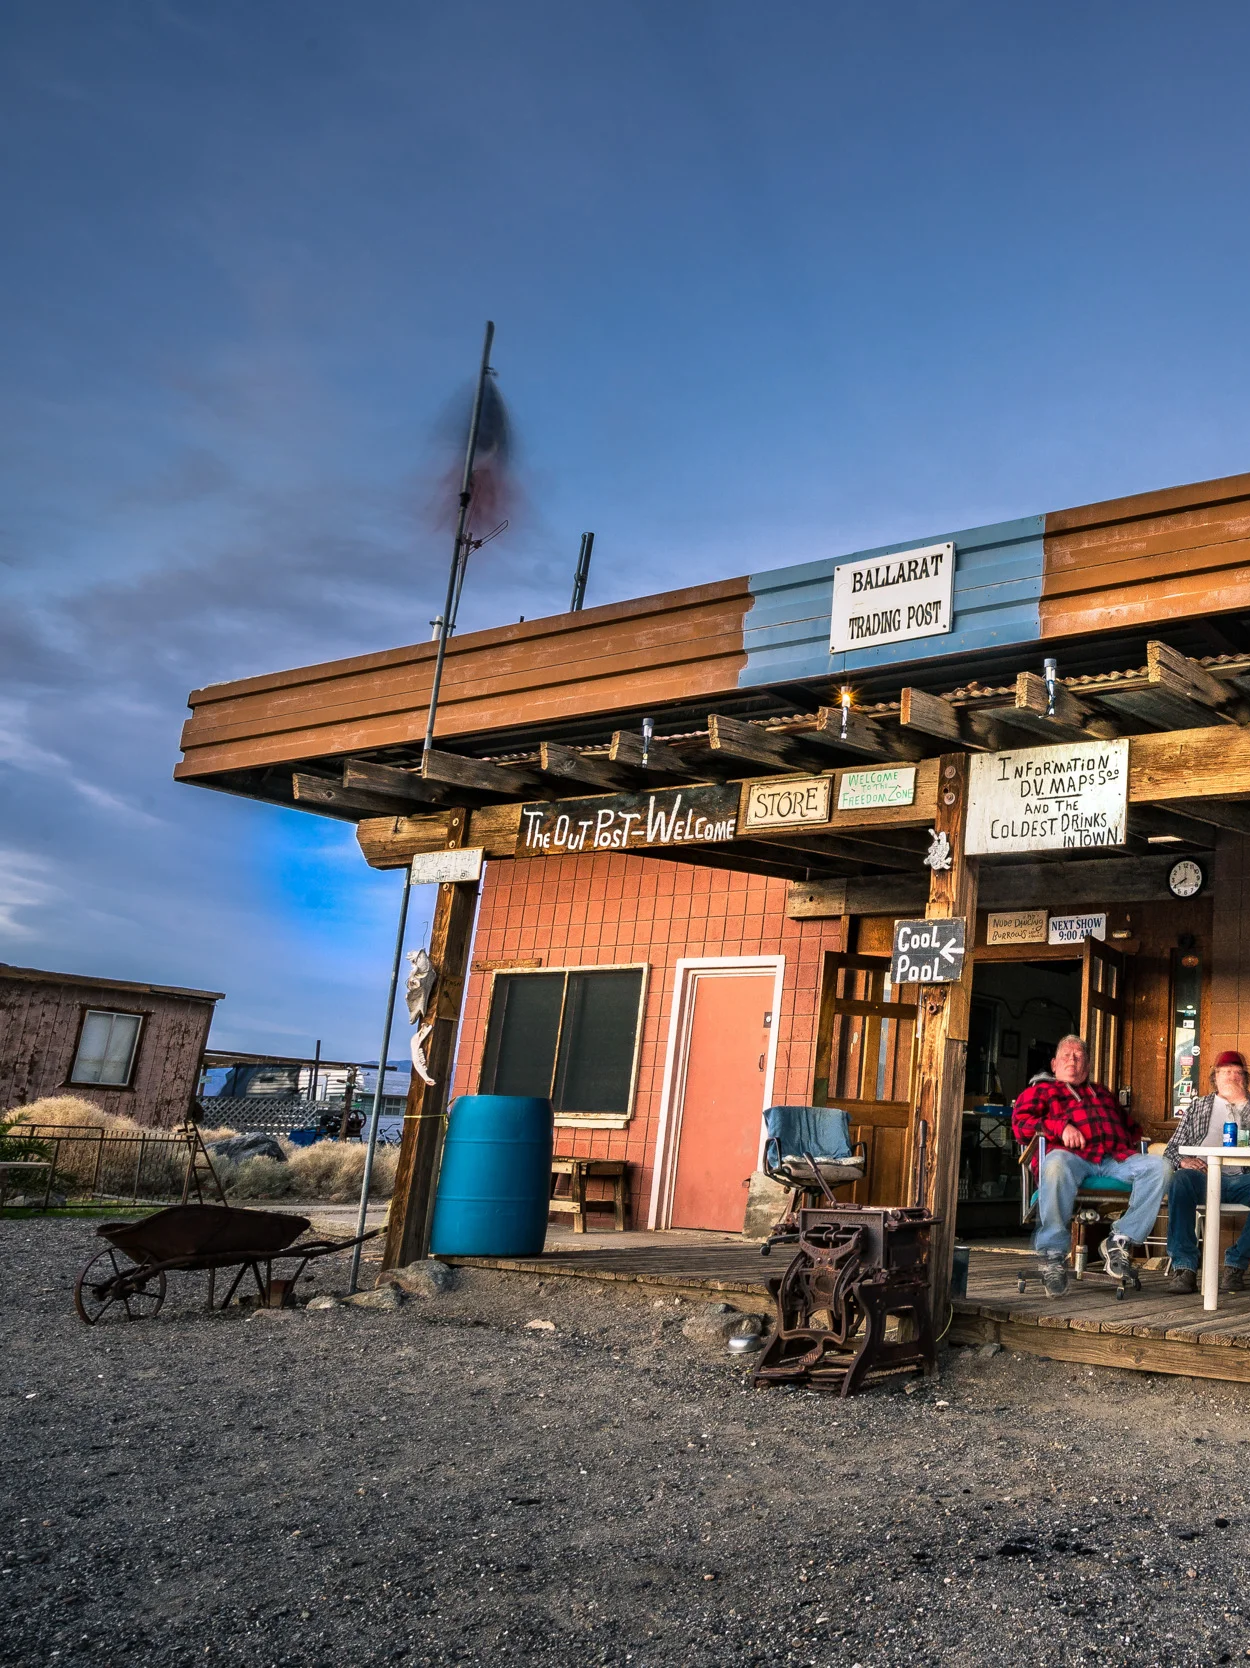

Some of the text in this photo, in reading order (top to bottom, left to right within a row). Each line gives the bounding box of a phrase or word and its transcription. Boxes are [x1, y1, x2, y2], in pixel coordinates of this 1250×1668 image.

[852, 554, 943, 593] BALLARAT
[849, 600, 942, 640] TRADING POST
[848, 772, 898, 787] WELCOME
[1050, 774, 1095, 795] MAPS
[754, 787, 818, 818] STORE
[842, 786, 914, 807] FREEDOM ZONE
[1024, 803, 1049, 815] AND
[1051, 917, 1103, 931] NEXT SHOW
[1058, 928, 1093, 940] 9:00 AM
